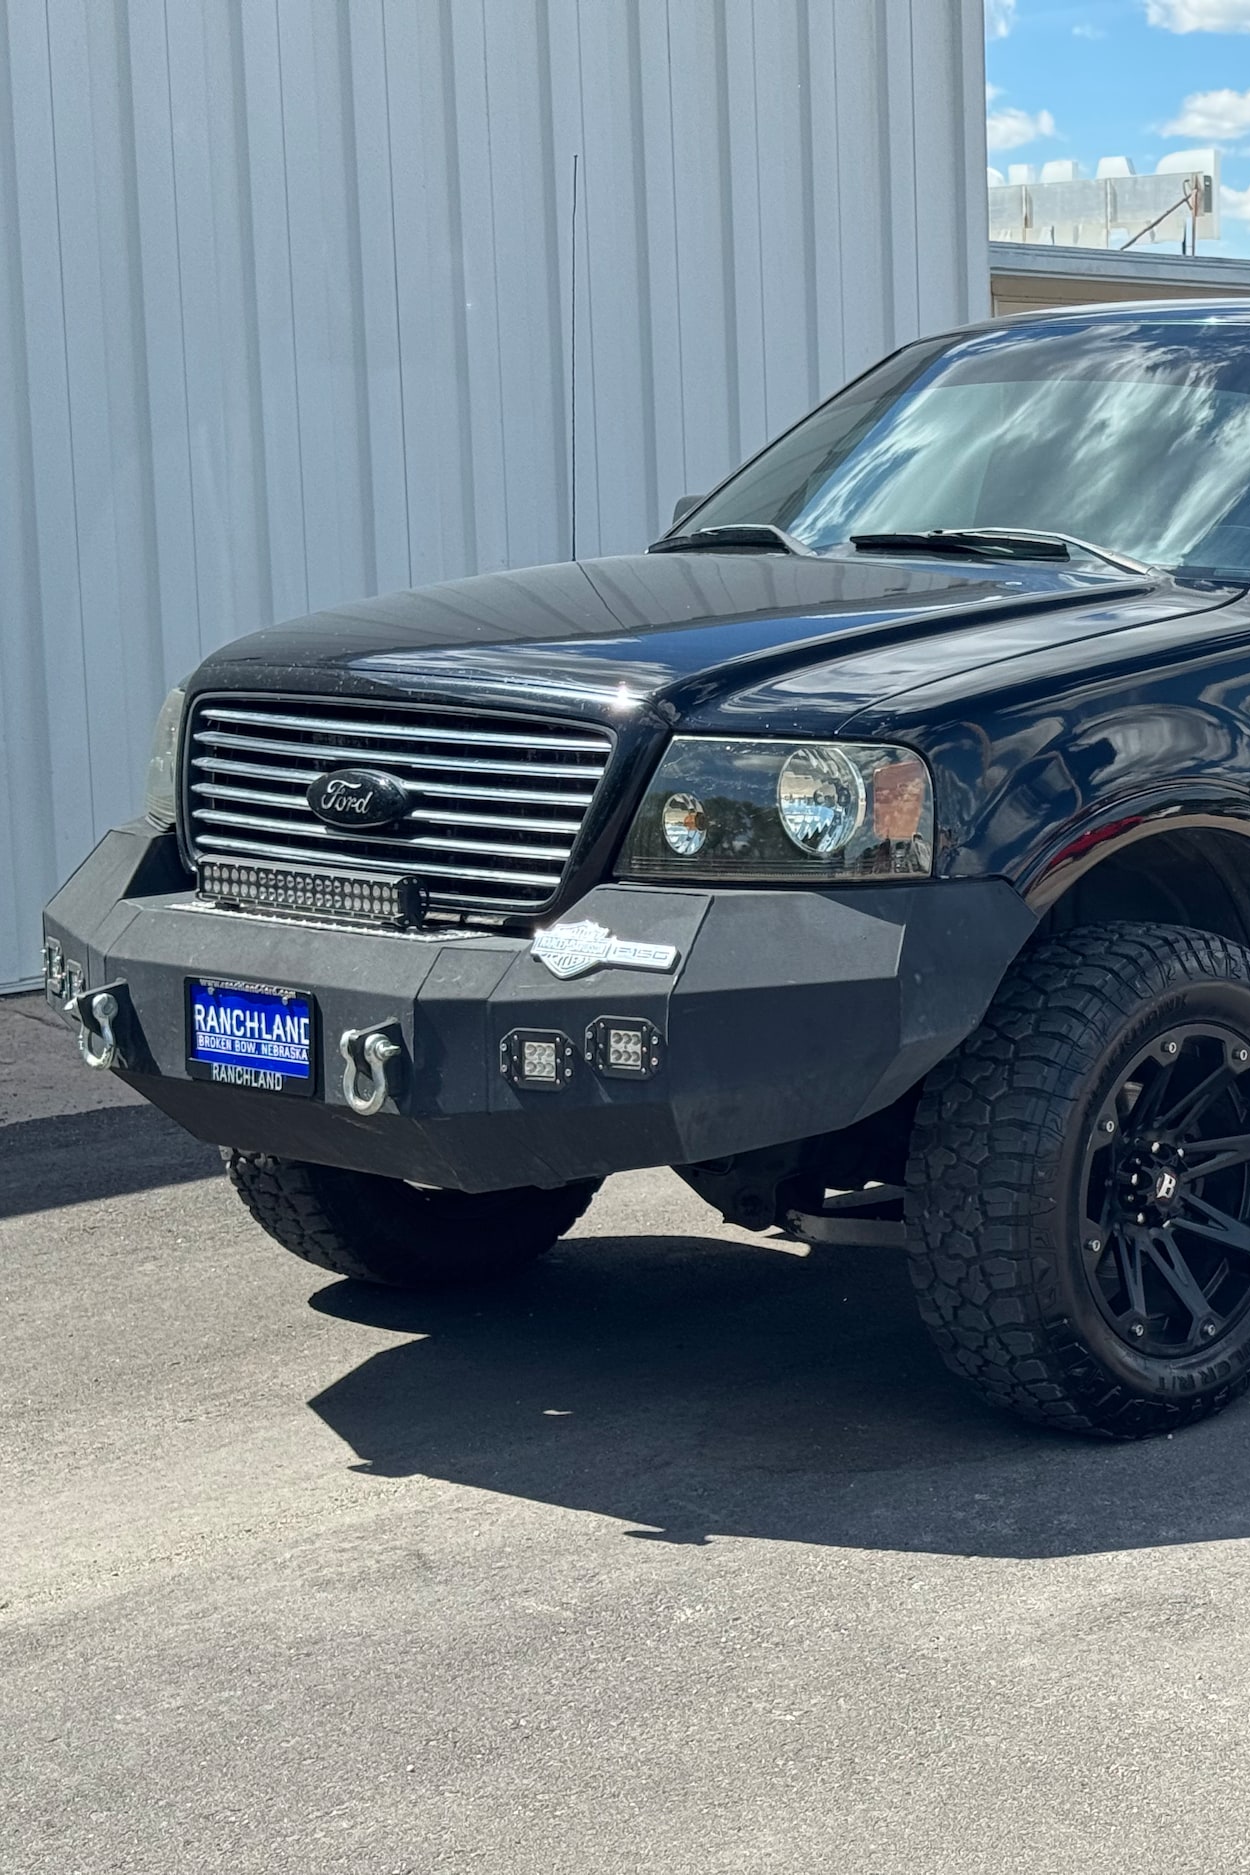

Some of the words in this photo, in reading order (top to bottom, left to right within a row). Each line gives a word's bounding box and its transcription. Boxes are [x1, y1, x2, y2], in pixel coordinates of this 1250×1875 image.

[321, 780, 374, 814] Ford
[197, 1035, 232, 1051] BROKEN
[261, 1044, 308, 1061] NEBRASKA
[212, 1063, 283, 1091] RANCHLAND
